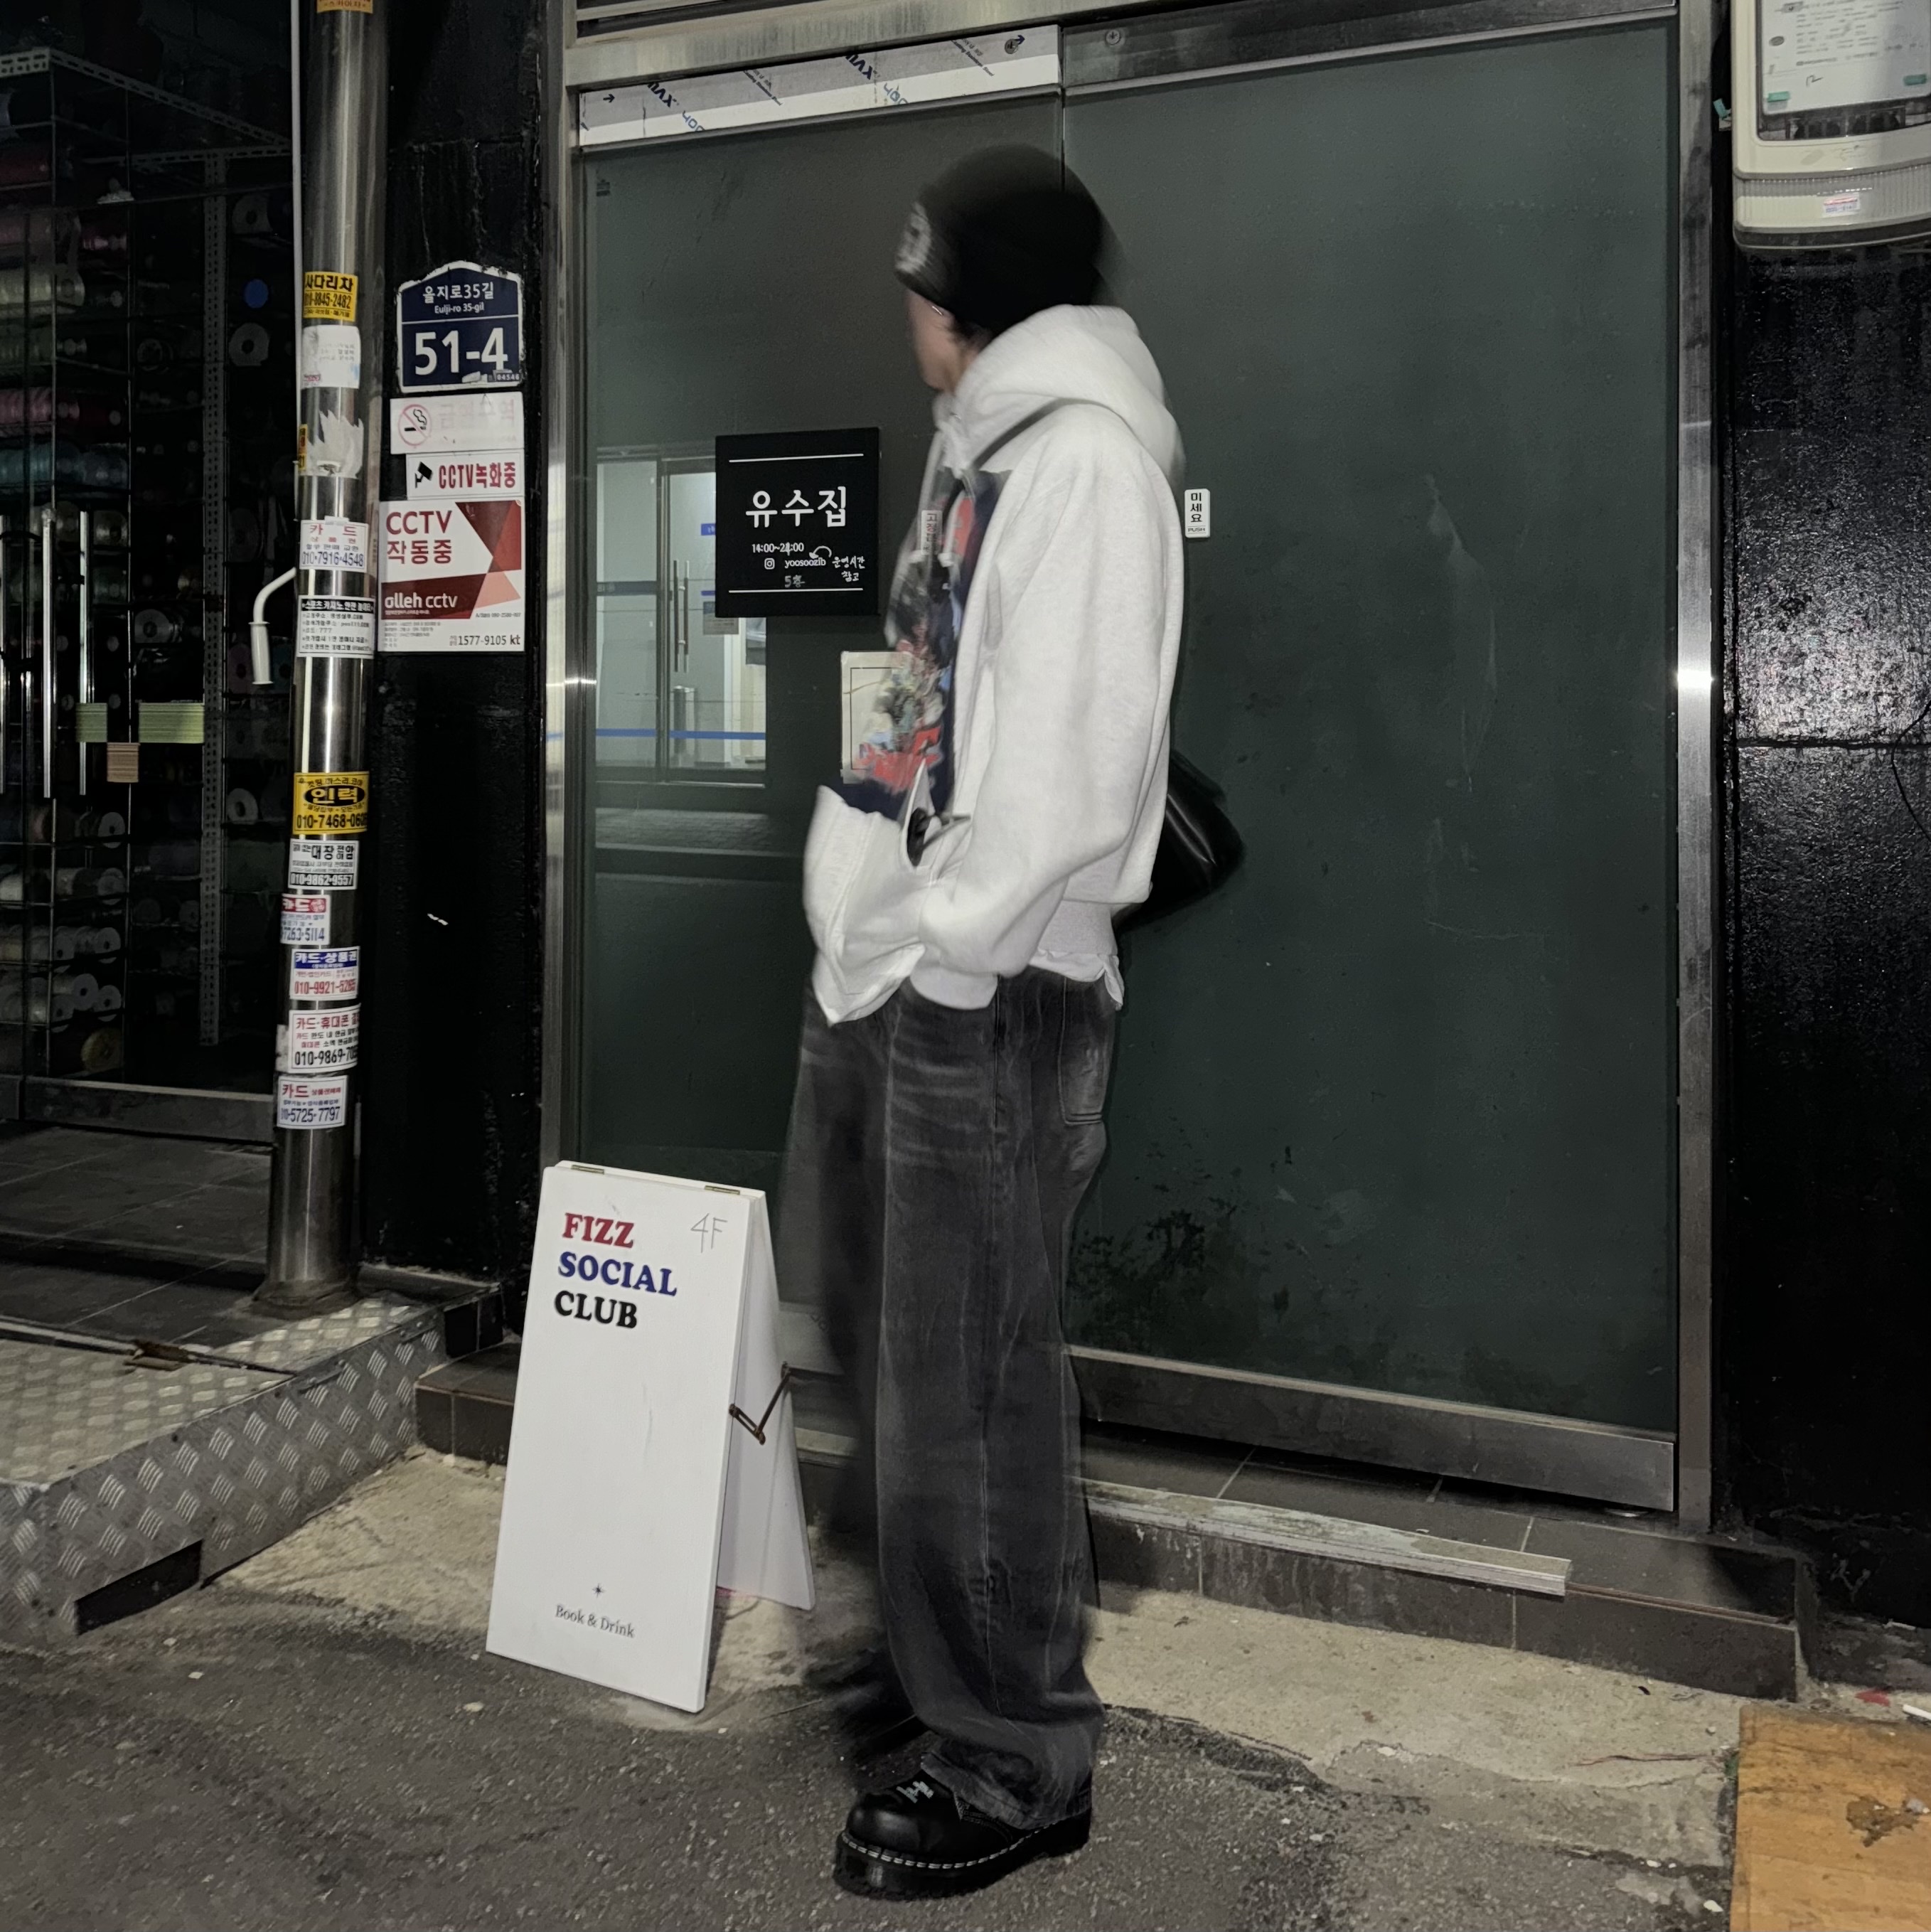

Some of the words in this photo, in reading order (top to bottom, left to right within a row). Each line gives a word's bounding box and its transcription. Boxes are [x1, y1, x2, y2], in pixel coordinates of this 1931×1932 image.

[304, 274, 353, 292] 사다리차
[422, 282, 494, 304] 을지로35길
[434, 304, 461, 315] Eulji-ro
[463, 301, 485, 314] 35-gil
[414, 327, 508, 375] 51-4
[438, 461, 515, 489] CCTV녹화중
[746, 486, 846, 528] 유수집
[1190, 492, 1202, 523] 미세요
[386, 510, 452, 535] CCTV
[387, 539, 452, 564] 작동중
[785, 557, 826, 569] yoosoozib
[832, 555, 865, 569] 운영시간
[841, 571, 859, 582] 참고
[385, 592, 422, 609] olleh
[425, 593, 458, 609] cctv
[458, 635, 506, 645] 1577-9105
[510, 634, 520, 645] kt
[311, 787, 358, 804] 인력
[282, 1084, 309, 1099] 카드
[562, 1212, 635, 1249] FIZZ
[690, 1213, 727, 1253] 4F
[558, 1251, 678, 1297] SOCIAL
[555, 1290, 637, 1328] CLUB
[555, 1604, 585, 1625] Book
[587, 1613, 597, 1628] &
[599, 1616, 636, 1639] Drink
